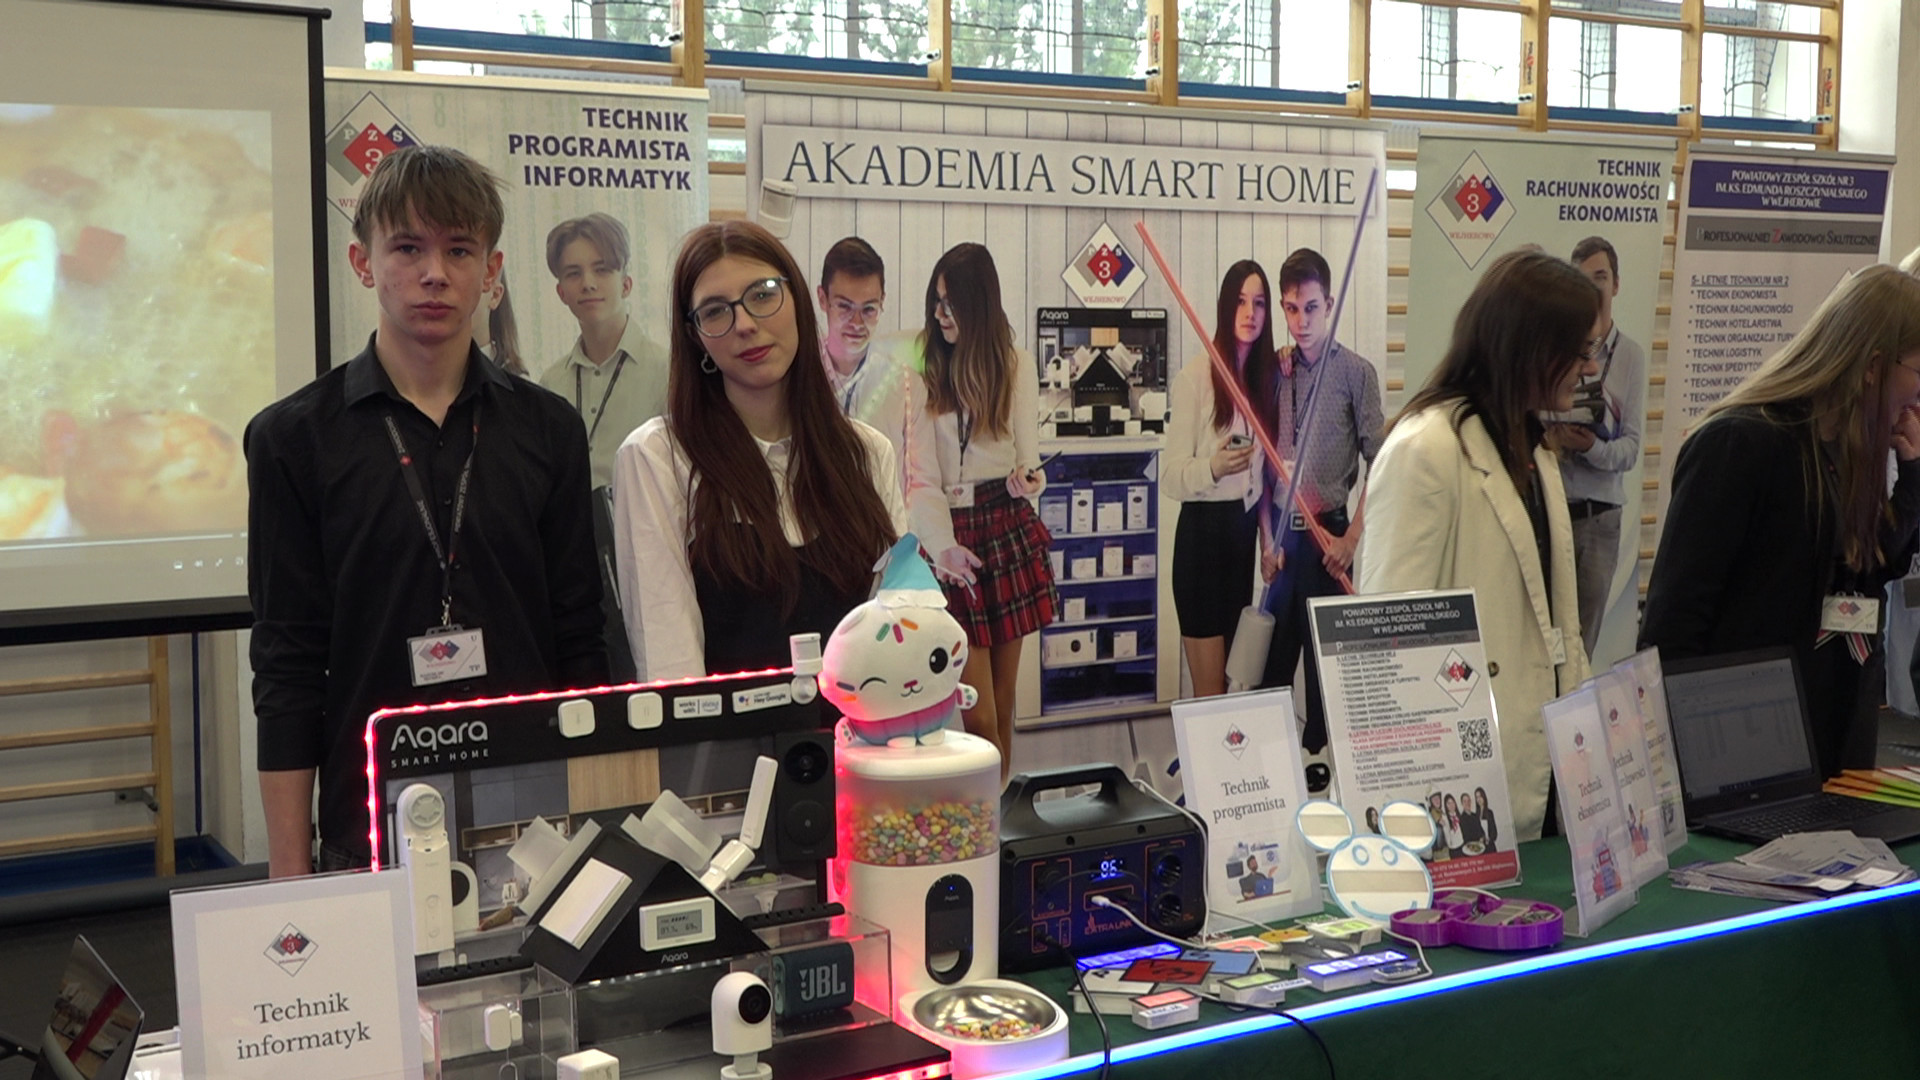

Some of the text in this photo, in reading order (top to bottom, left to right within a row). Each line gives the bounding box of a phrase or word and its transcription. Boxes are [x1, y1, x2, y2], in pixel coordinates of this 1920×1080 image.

[582, 107, 689, 132] TECHNIK
[508, 134, 691, 161] PROGRAMISTA
[524, 164, 692, 191] INFORMATYK
[782, 140, 1356, 205] AKADEMIA SMART HOME
[1598, 159, 1661, 177] TECHNIK
[1732, 170, 1781, 182] POWIATOWY
[1838, 175, 1849, 186] NR
[1526, 180, 1660, 201] RACHUNKOWOŚCI
[1742, 183, 1784, 195] EDMUNDA
[1466, 193, 1480, 213] 3
[1559, 204, 1659, 223] EKONOMISTA
[1098, 260, 1111, 279] 3
[1702, 275, 1728, 285] LETNIE
[1730, 275, 1771, 286] TECHNIKUM
[1697, 290, 1777, 299] TECHNIK EKONOMISTA
[1696, 304, 1728, 314] TECHNIK
[1695, 319, 1782, 328] TECHNIK HOTELARSTWA
[1694, 334, 1728, 343] TECHNIK
[1692, 348, 1762, 358] TECHNIK LOGISTYK
[1691, 363, 1723, 373] TECHNIK
[1691, 378, 1722, 388] TECHNIK
[1343, 607, 1384, 617] POWIATOWY
[390, 721, 488, 751] Aqara
[391, 748, 489, 769] SMART HOME
[1220, 776, 1270, 796] Technik
[1213, 797, 1286, 824] programista
[661, 952, 689, 964] Aqara
[799, 963, 847, 1001] JBL
[253, 992, 350, 1024] Technik
[237, 1021, 371, 1060] informatyk
